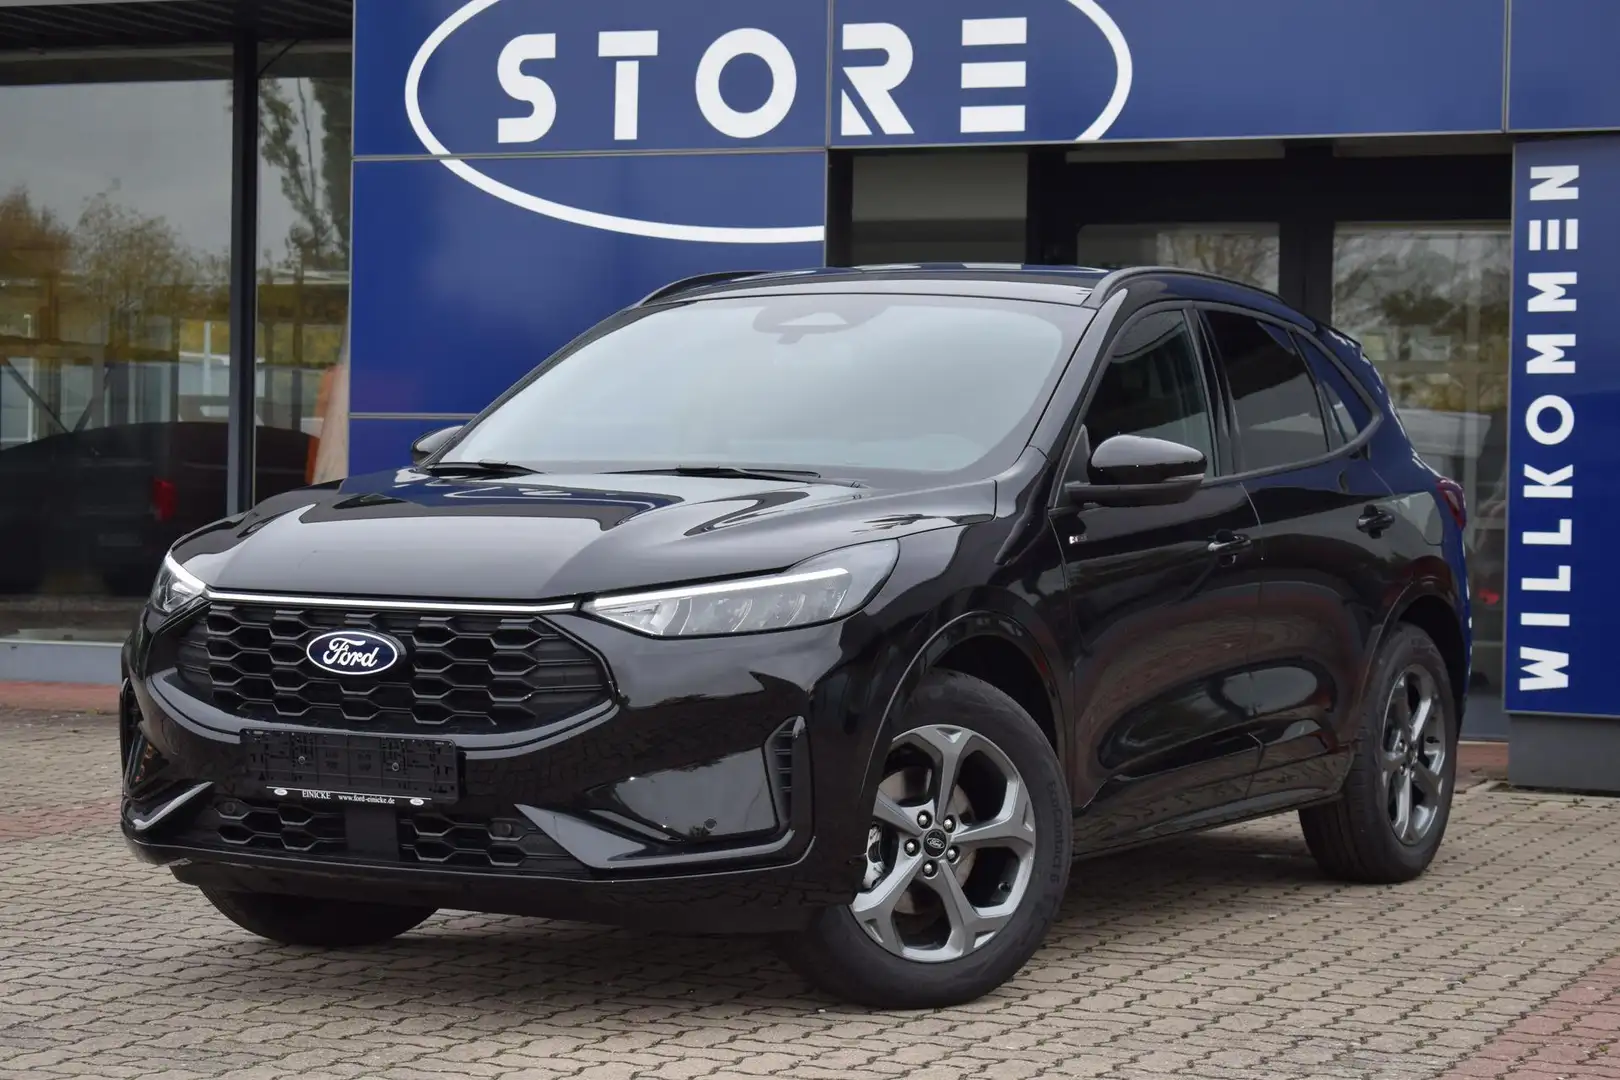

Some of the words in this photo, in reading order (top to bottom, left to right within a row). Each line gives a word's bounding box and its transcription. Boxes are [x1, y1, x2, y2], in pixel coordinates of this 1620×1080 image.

[497, 16, 1028, 143] STORE
[1519, 164, 1580, 691] WILLKOMMEN
[323, 637, 380, 668] Ford
[302, 789, 331, 800] EINICKE
[338, 794, 395, 804] www.ford-einicke.de
